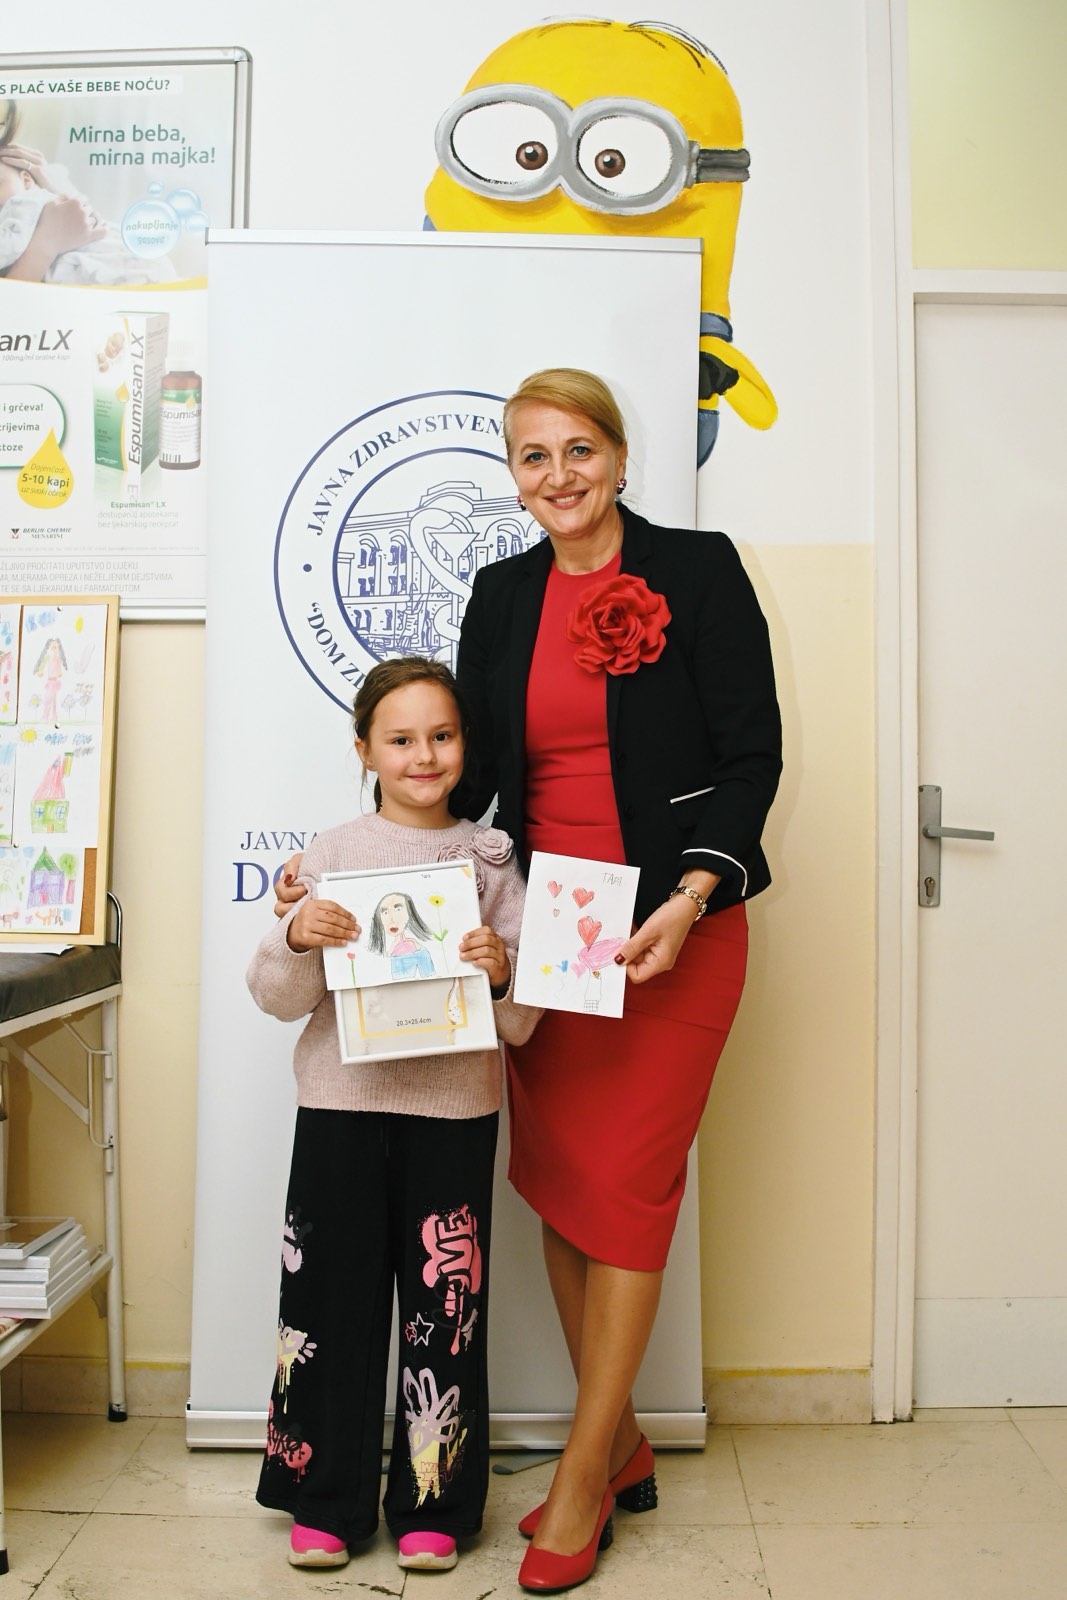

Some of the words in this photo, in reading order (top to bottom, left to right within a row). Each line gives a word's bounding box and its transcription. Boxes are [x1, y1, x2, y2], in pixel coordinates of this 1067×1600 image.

[10, 79, 45, 95] PLAČ
[48, 79, 83, 93] VAŠE
[86, 80, 121, 92] BEBE
[124, 77, 171, 92] NOĆU?
[69, 125, 125, 144] Mirna
[132, 123, 186, 145] beba,
[89, 148, 145, 166] mirna
[151, 146, 216, 168] majka!
[38, 329, 74, 351] LX
[131, 332, 145, 360] LX
[8, 402, 44, 414] grčeva!
[128, 363, 144, 465] Espumisan
[21, 472, 45, 485] 5-10
[46, 475, 70, 489] kapi
[306, 466, 355, 537] JAVNA
[349, 413, 505, 470] ZDRAVSTVEN
